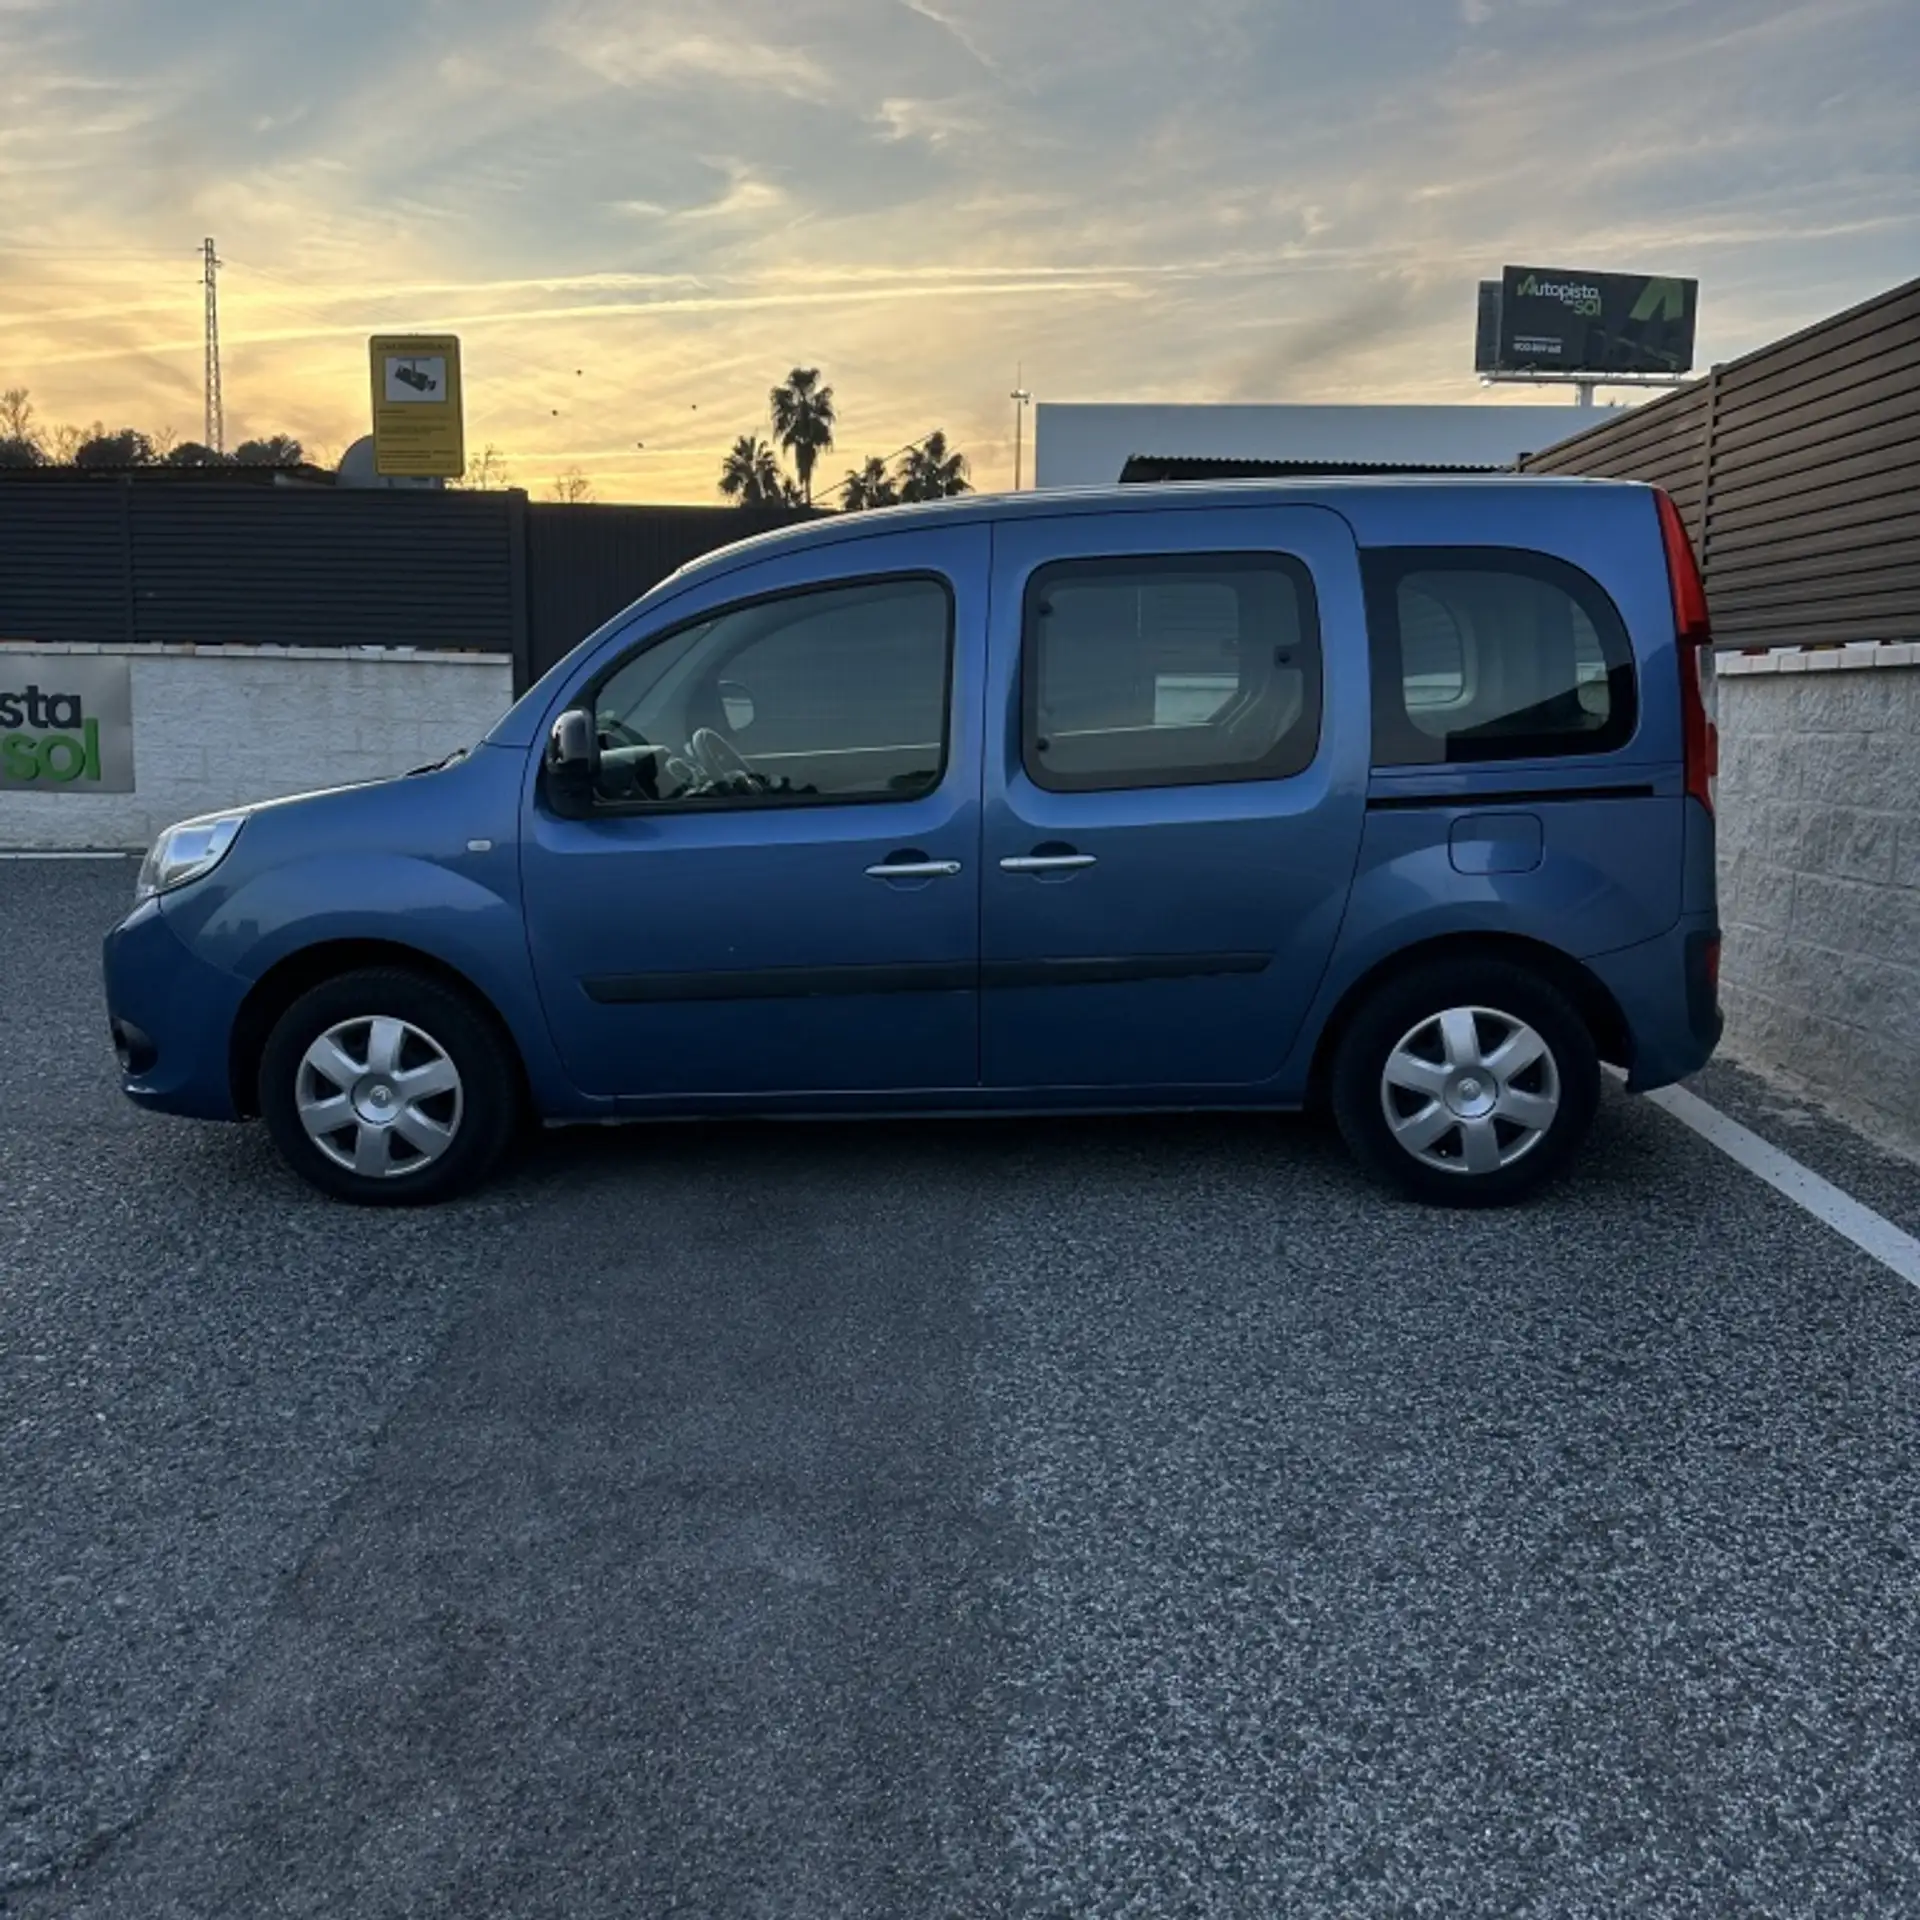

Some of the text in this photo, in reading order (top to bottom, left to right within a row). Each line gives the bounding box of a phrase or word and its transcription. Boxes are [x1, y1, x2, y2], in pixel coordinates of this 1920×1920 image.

[1516, 274, 1599, 301] Autopista
[1574, 296, 1602, 316] sol
[0, 685, 82, 728] sta
[2, 717, 101, 782] sol
